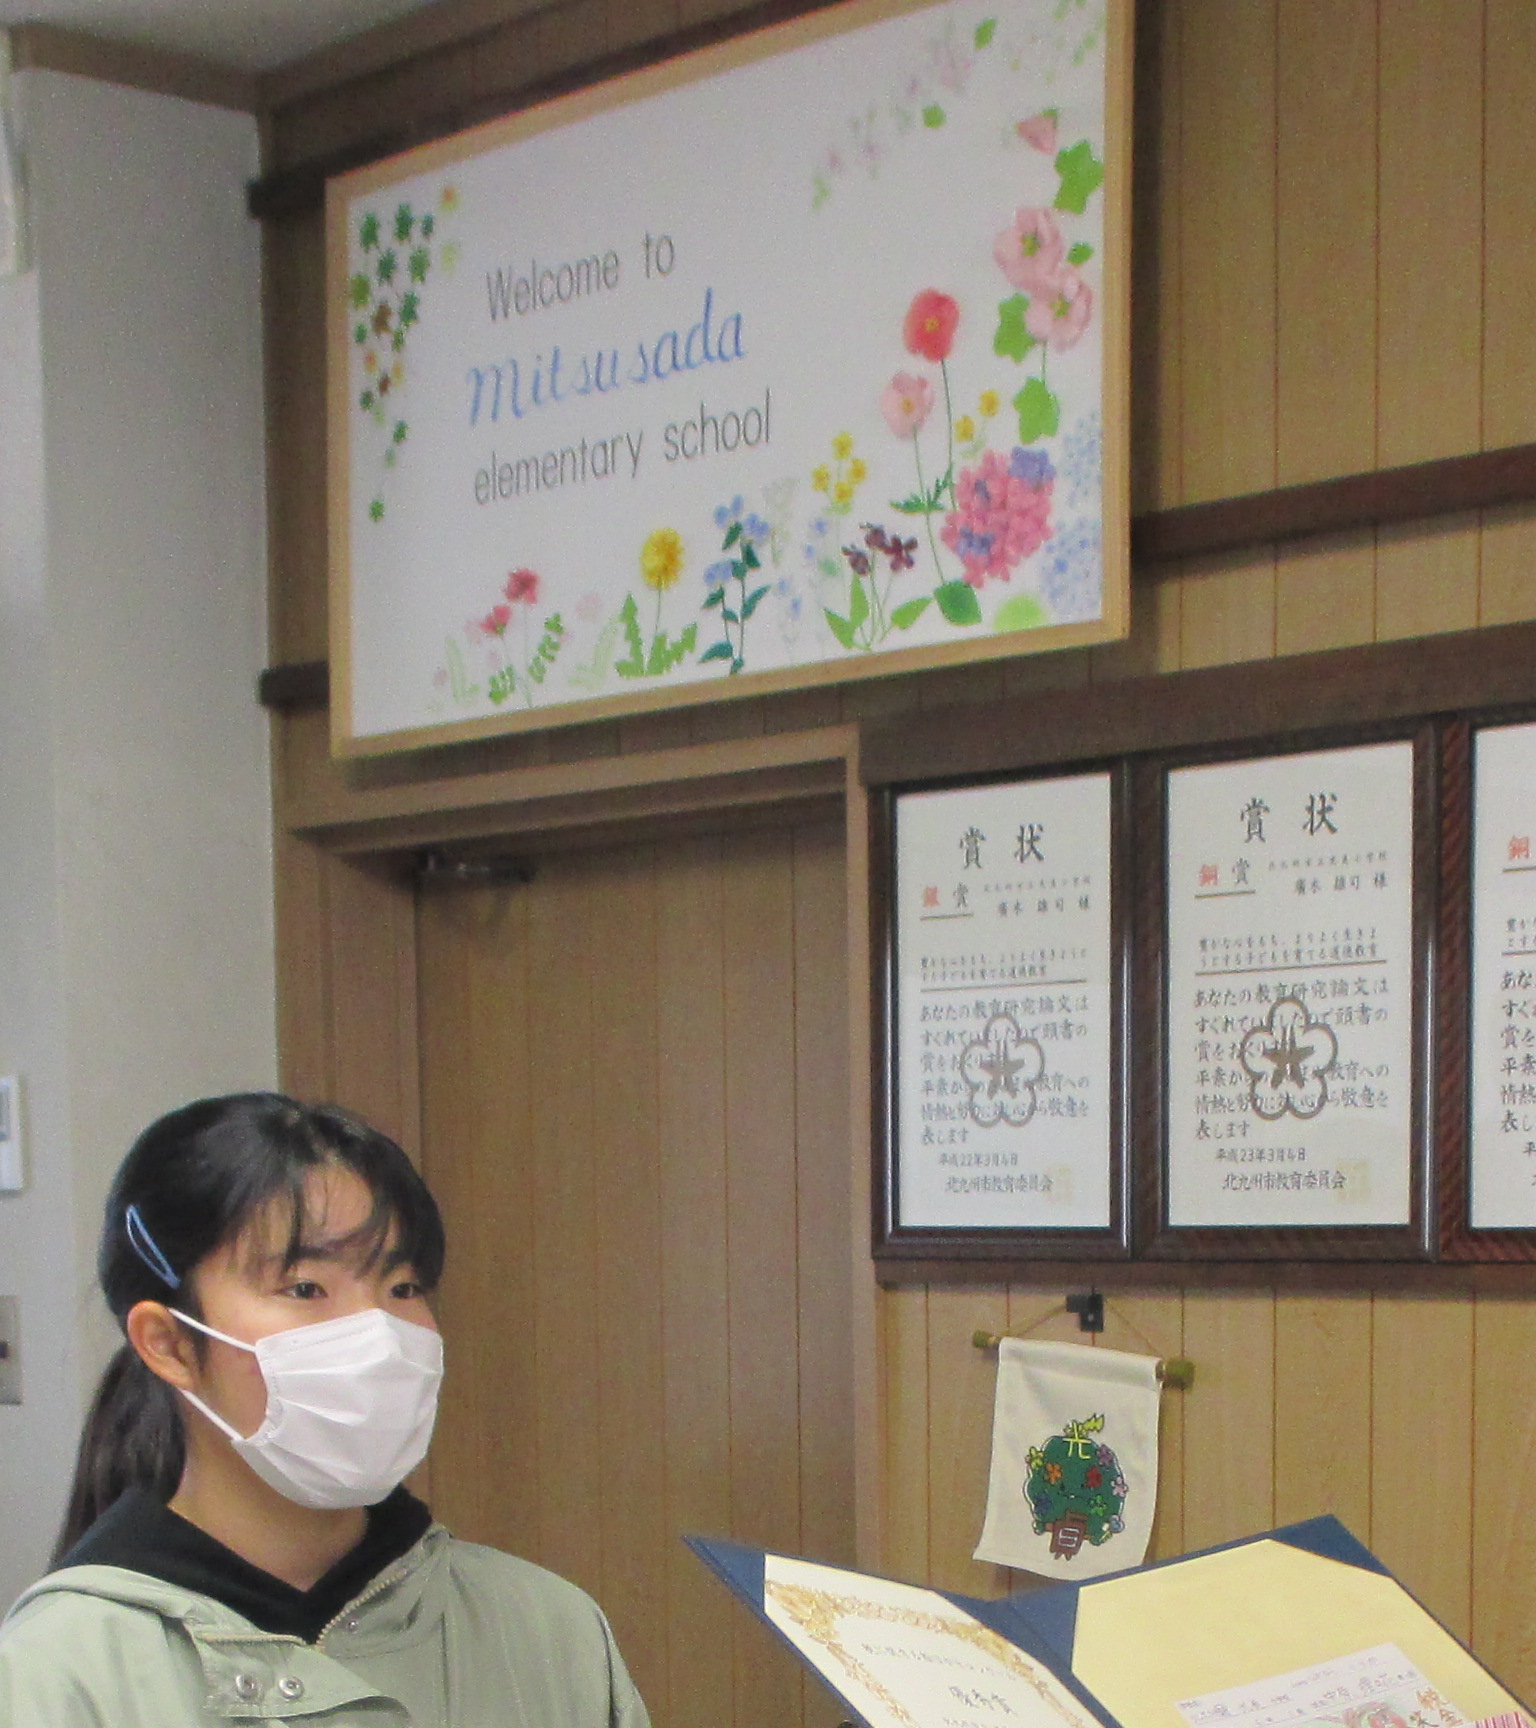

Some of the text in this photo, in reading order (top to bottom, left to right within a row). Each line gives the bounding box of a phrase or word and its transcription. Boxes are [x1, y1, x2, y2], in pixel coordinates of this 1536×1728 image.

[485, 230, 675, 322] Welcome to
[467, 286, 747, 426] Mitsusada
[474, 386, 771, 505] elementary school
[1239, 790, 1340, 844] 賞状
[958, 822, 1046, 870] 賞状
[1194, 976, 1390, 1009] あなたの教育研究論文は
[920, 1124, 971, 1146] 表します
[1195, 1118, 1252, 1141] 表します
[1221, 1169, 1349, 1192] 北九州市教育委員会
